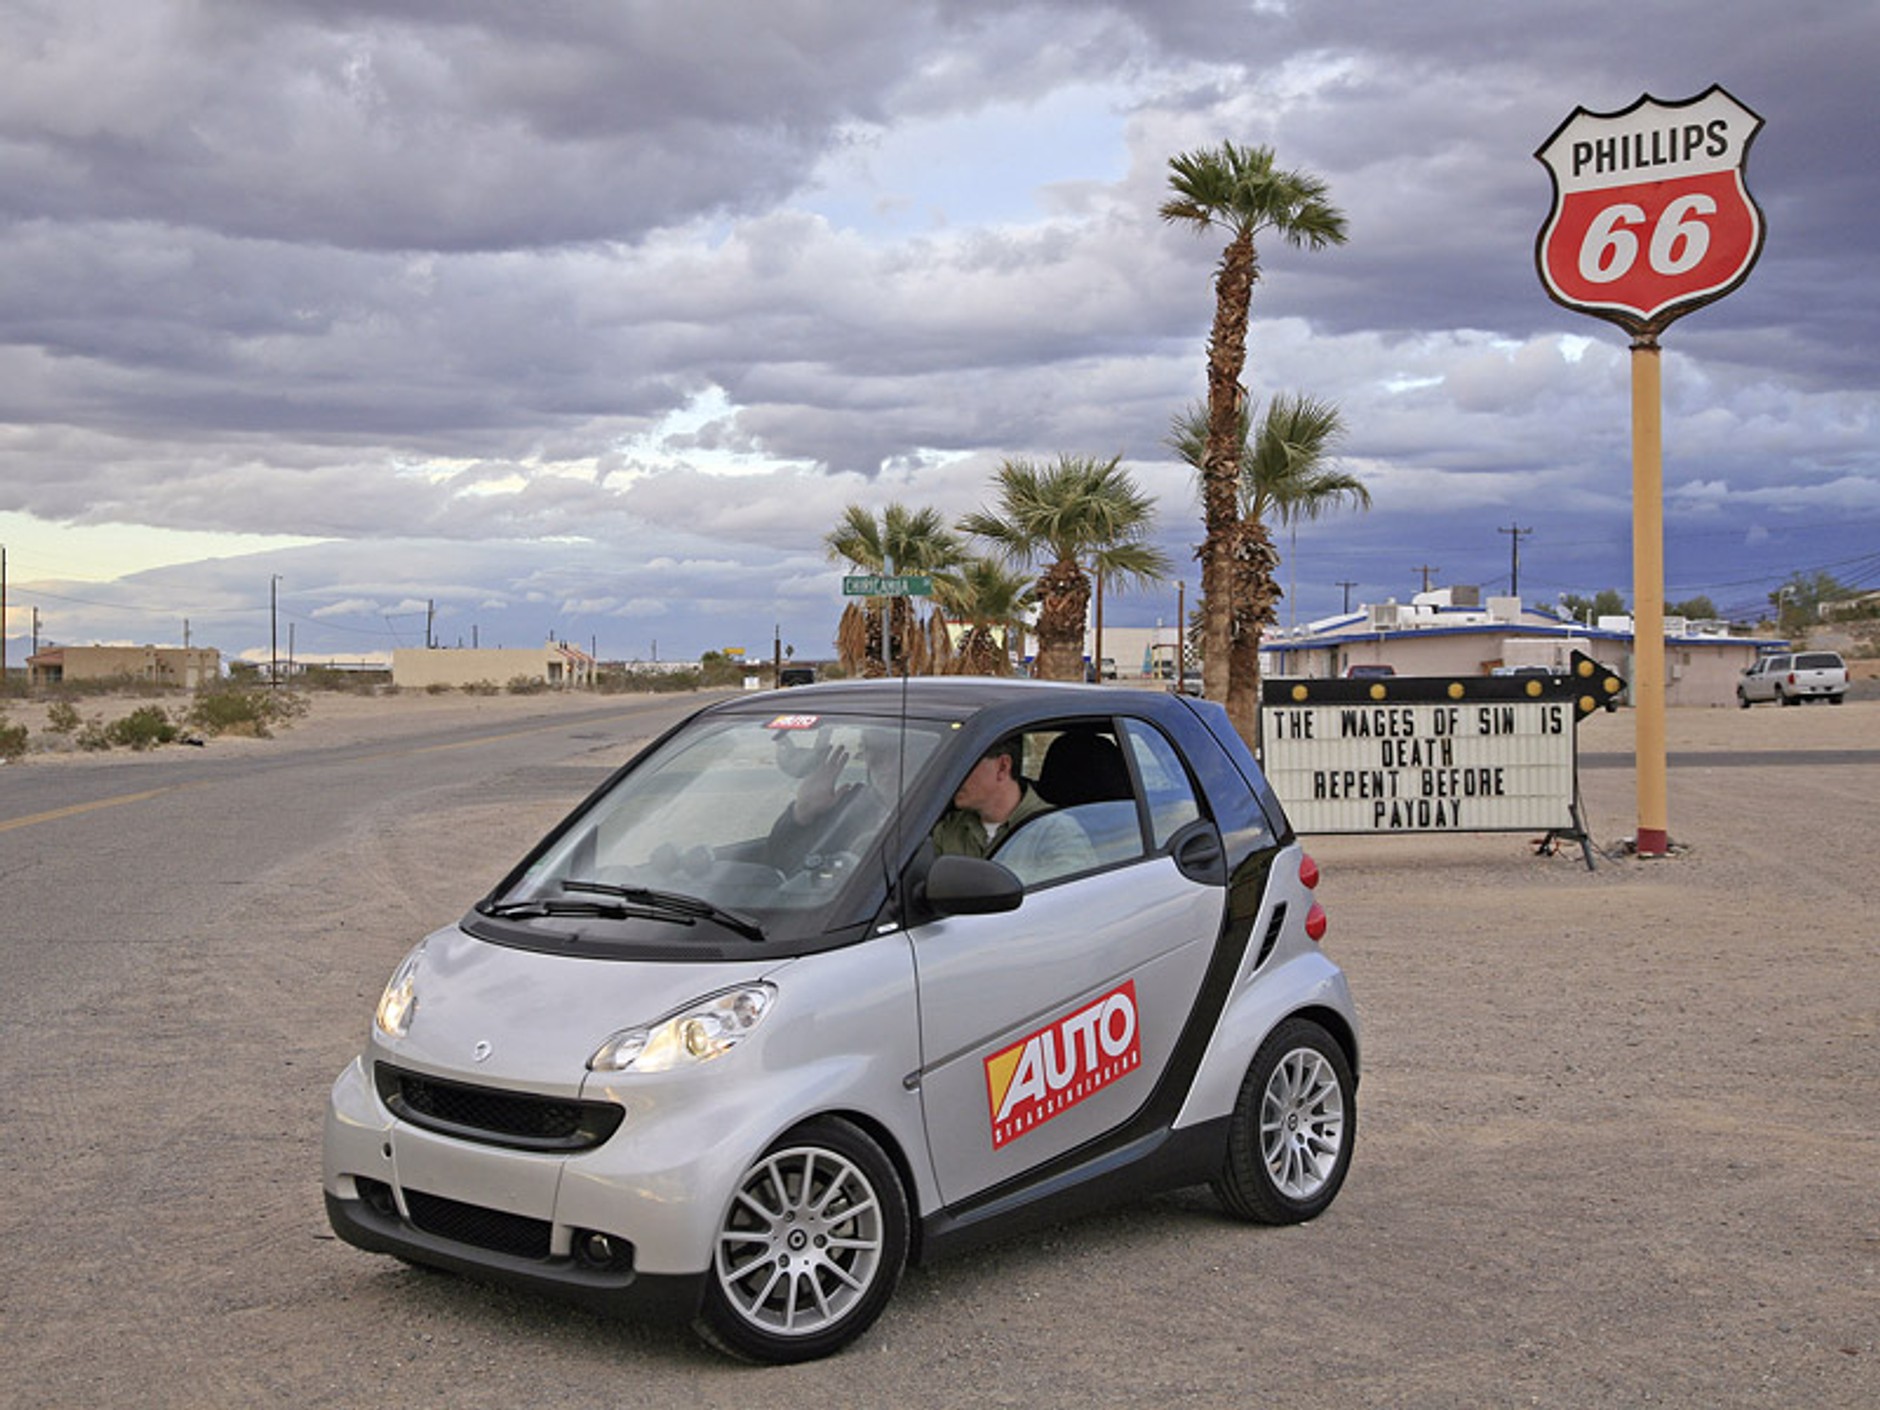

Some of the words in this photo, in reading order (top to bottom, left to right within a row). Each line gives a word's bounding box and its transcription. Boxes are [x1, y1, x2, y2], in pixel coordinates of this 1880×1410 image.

[1572, 119, 1729, 177] PHILLIPS
[1578, 193, 1717, 284] 66
[1273, 710, 1314, 740] THE
[1341, 708, 1415, 739] WAGES
[1434, 707, 1459, 737] OF
[1480, 706, 1515, 736] SIN
[1541, 706, 1563, 734] IS
[1381, 738, 1454, 768] DEATH
[1314, 770, 1399, 799] REPENT
[1422, 767, 1505, 797] BEFORE
[1374, 800, 1461, 829] PAYDAY
[996, 992, 1136, 1124] AUTO
